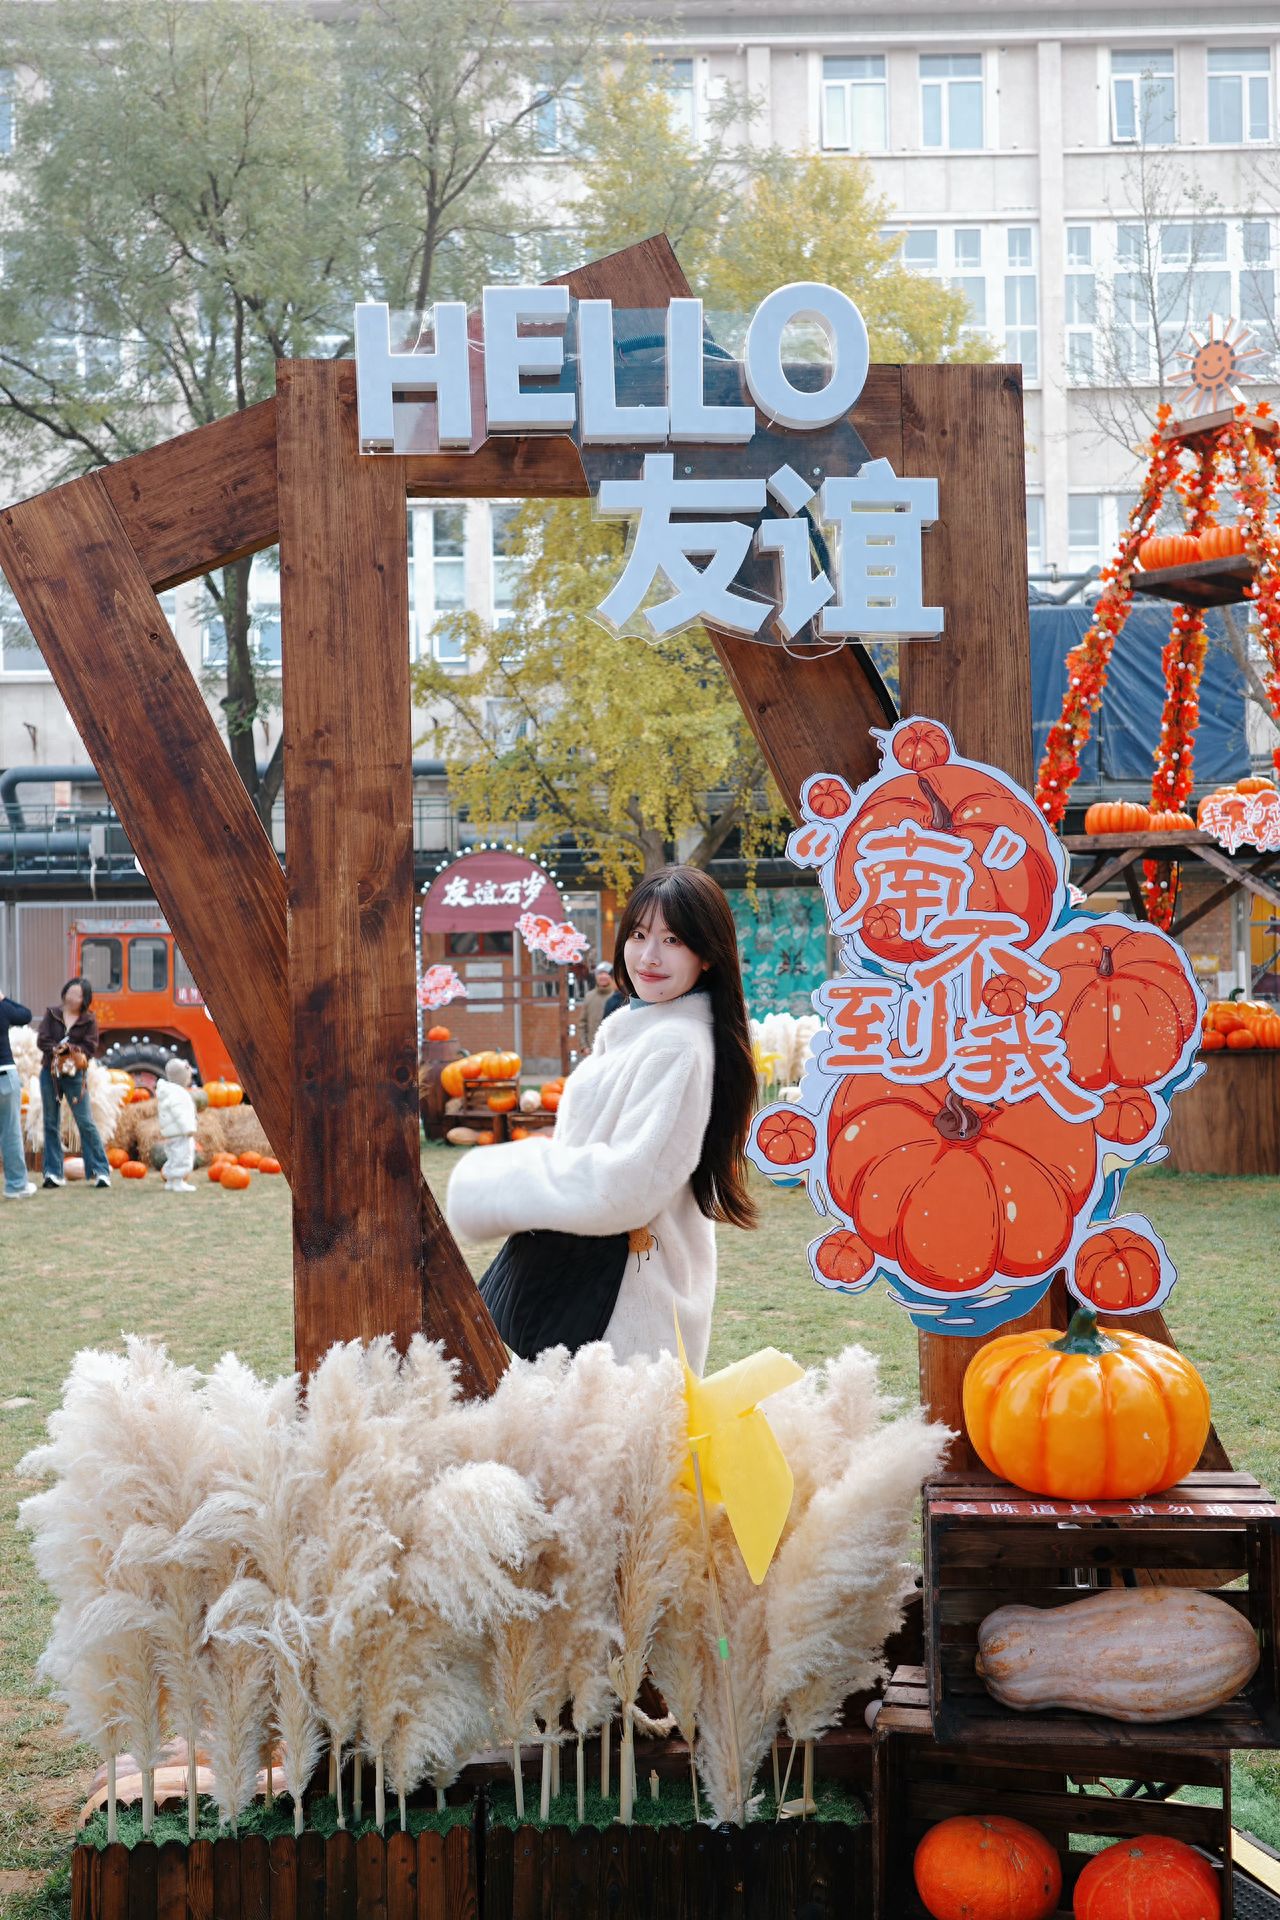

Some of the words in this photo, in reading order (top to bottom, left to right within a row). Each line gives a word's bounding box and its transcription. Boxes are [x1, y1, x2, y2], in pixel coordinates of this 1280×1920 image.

[355, 282, 870, 449] HELLO
[596, 453, 945, 640] 友谊
[441, 871, 547, 910] 友谊万岁
[951, 1502, 1097, 1515] 美陈道具
[1128, 1503, 1276, 1517] 请勿搬动
